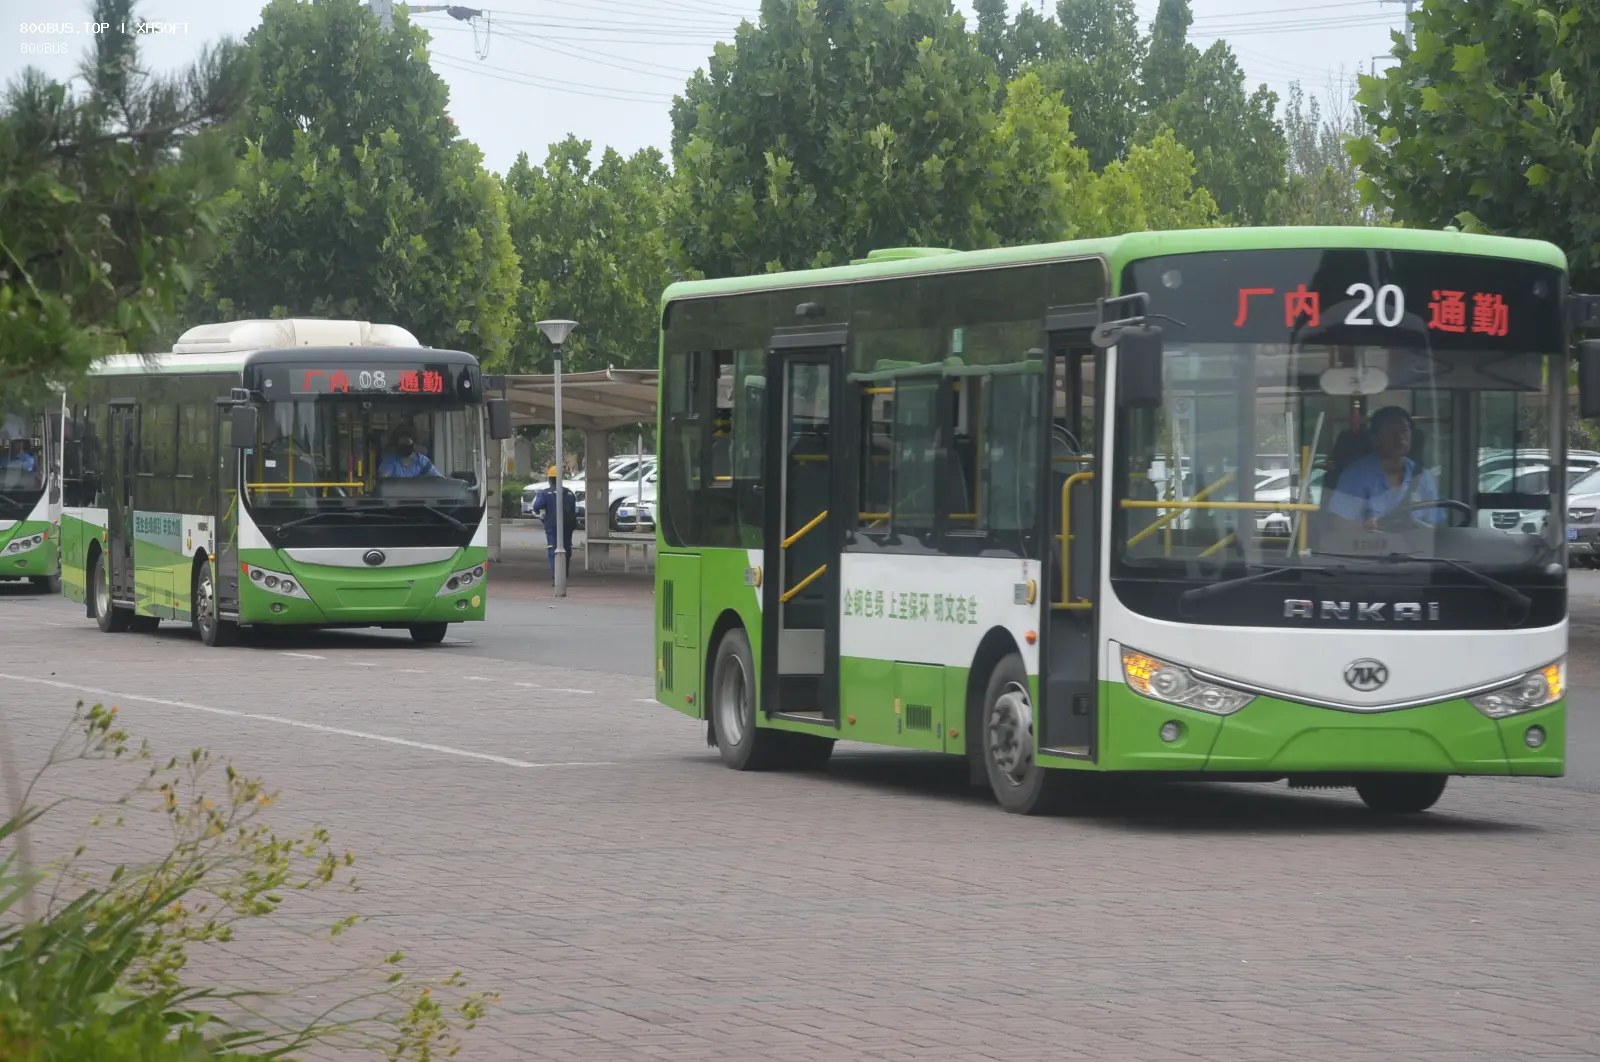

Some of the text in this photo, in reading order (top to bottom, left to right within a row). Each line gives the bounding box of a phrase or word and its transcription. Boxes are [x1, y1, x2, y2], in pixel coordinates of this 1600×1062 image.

[1233, 282, 1510, 337] 厂内 20 通勤
[302, 370, 443, 393] 厂内 08 通勤
